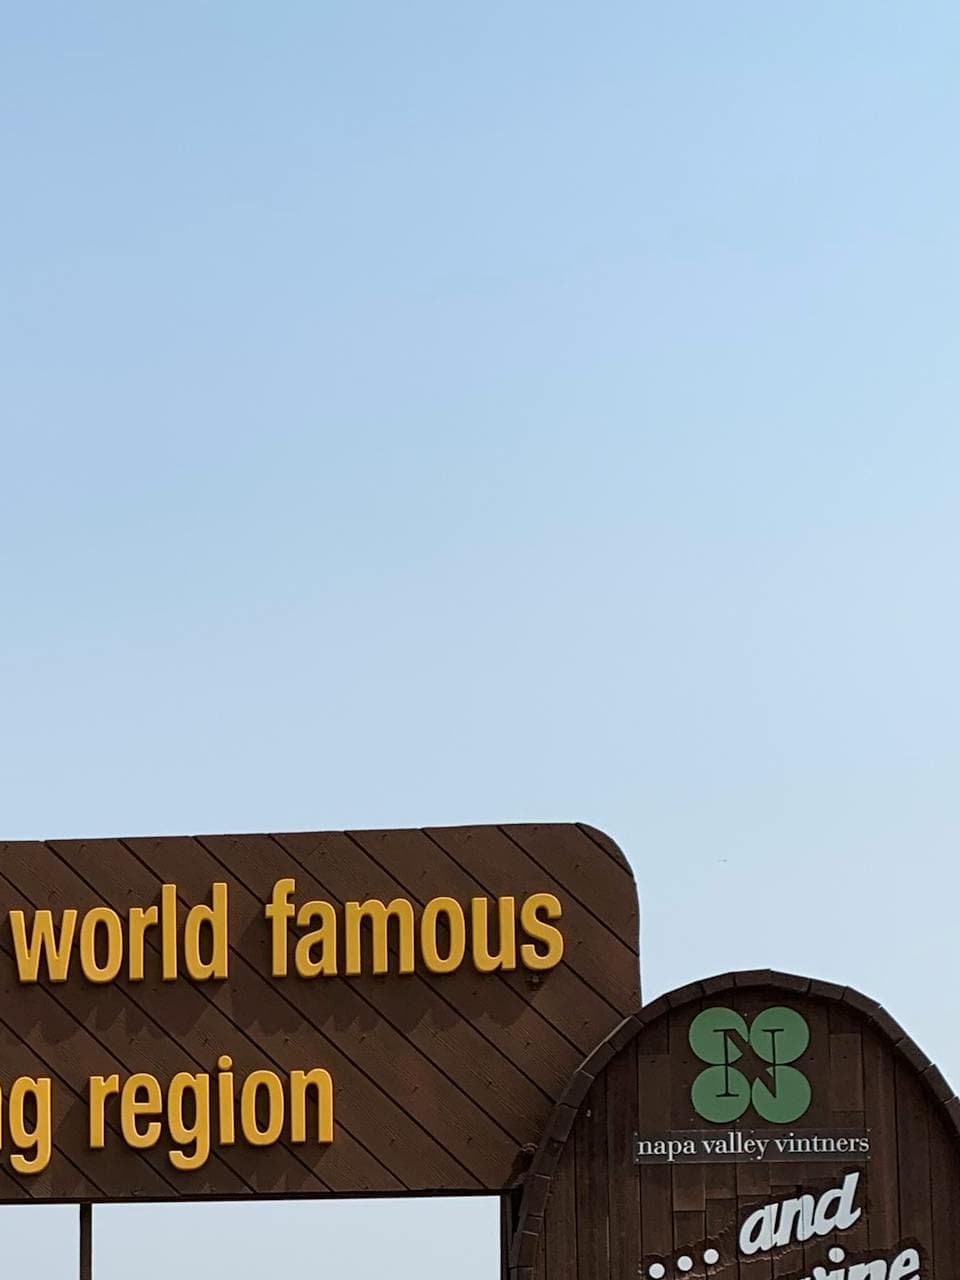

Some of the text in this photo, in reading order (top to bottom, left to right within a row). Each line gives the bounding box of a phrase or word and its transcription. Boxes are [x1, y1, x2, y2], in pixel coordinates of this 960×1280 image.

[9, 882, 229, 984] world
[265, 878, 565, 977] famous
[89, 1054, 334, 1171] region
[637, 1131, 870, 1162] napa valley vintners
